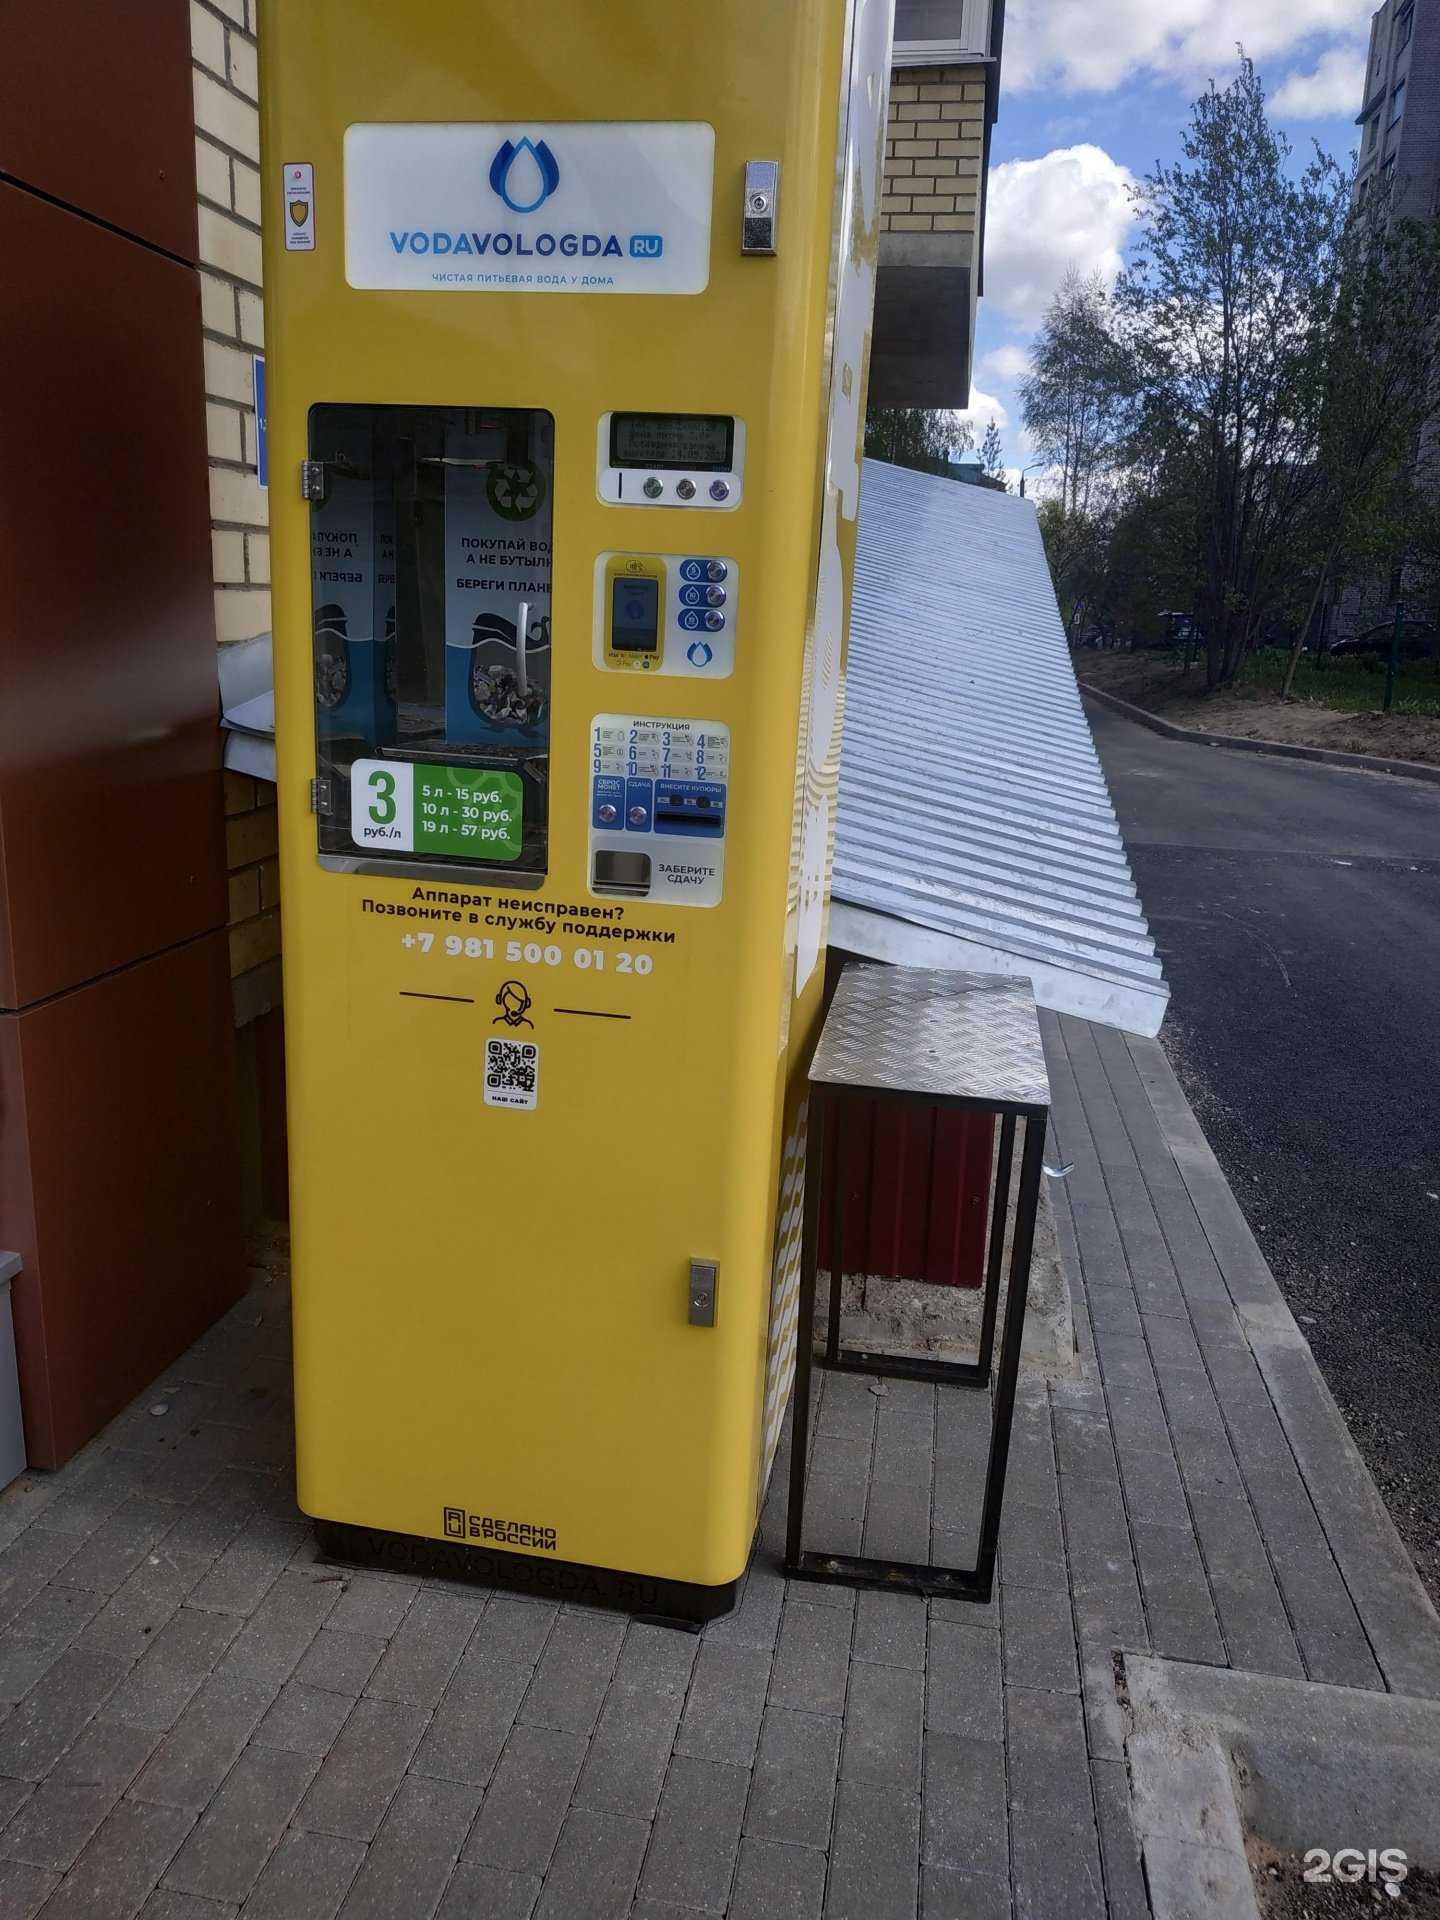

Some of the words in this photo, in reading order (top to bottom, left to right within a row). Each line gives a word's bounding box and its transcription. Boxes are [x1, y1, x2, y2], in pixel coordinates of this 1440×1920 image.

[389, 230, 623, 257] VODAVOLOGDA
[632, 237, 660, 255] RU
[432, 272, 473, 284] ЧИСТАЯ
[477, 273, 533, 285] ПИТЬЕВАЯ
[536, 274, 567, 285] ВОДА
[572, 276, 578, 285] У
[581, 276, 614, 287] ДОМА
[461, 537, 525, 551] ПОКУПАЙ
[466, 553, 475, 564] А
[479, 554, 496, 565] НЕ
[456, 578, 504, 590] БЕРЕГИ
[633, 720, 690, 730] ИНСТРУКЦИЯ
[594, 727, 601, 742] 1
[629, 729, 638, 744] 2
[662, 732, 671, 746] 3
[696, 735, 705, 749] 4
[594, 743, 601, 758] 5
[629, 746, 637, 760] 6
[662, 748, 670, 762] 7
[696, 750, 704, 764] 8
[593, 759, 601, 773] 9
[626, 761, 637, 776] 10
[661, 764, 671, 778] 11
[696, 766, 706, 780] 12
[368, 770, 397, 825] 3
[422, 785, 430, 796] 5
[434, 788, 443, 797] л
[456, 788, 469, 800] 15
[473, 789, 502, 804] руб.
[422, 803, 436, 814] 10
[440, 806, 449, 816] л
[462, 807, 479, 819] 30
[483, 809, 512, 824] руб.
[364, 826, 401, 839] руб./л
[422, 821, 436, 833] 19
[439, 825, 448, 834] л
[461, 824, 478, 837] 57
[481, 827, 510, 842] руб.
[658, 864, 715, 876] ЗАБЕРИТЕ
[668, 874, 704, 884] СДАЧУ
[412, 887, 492, 907] Аппарат
[498, 897, 624, 921] неисправен?
[362, 899, 462, 923] Позвоните
[469, 912, 479, 924] в
[485, 914, 556, 934] службу
[562, 922, 675, 943] поддержки
[401, 932, 434, 952] +7
[445, 936, 494, 959] 981
[506, 941, 562, 966] 500
[573, 948, 604, 970] 01
[615, 952, 653, 975] 20
[469, 1515, 556, 1539] СДЕЛАНО
